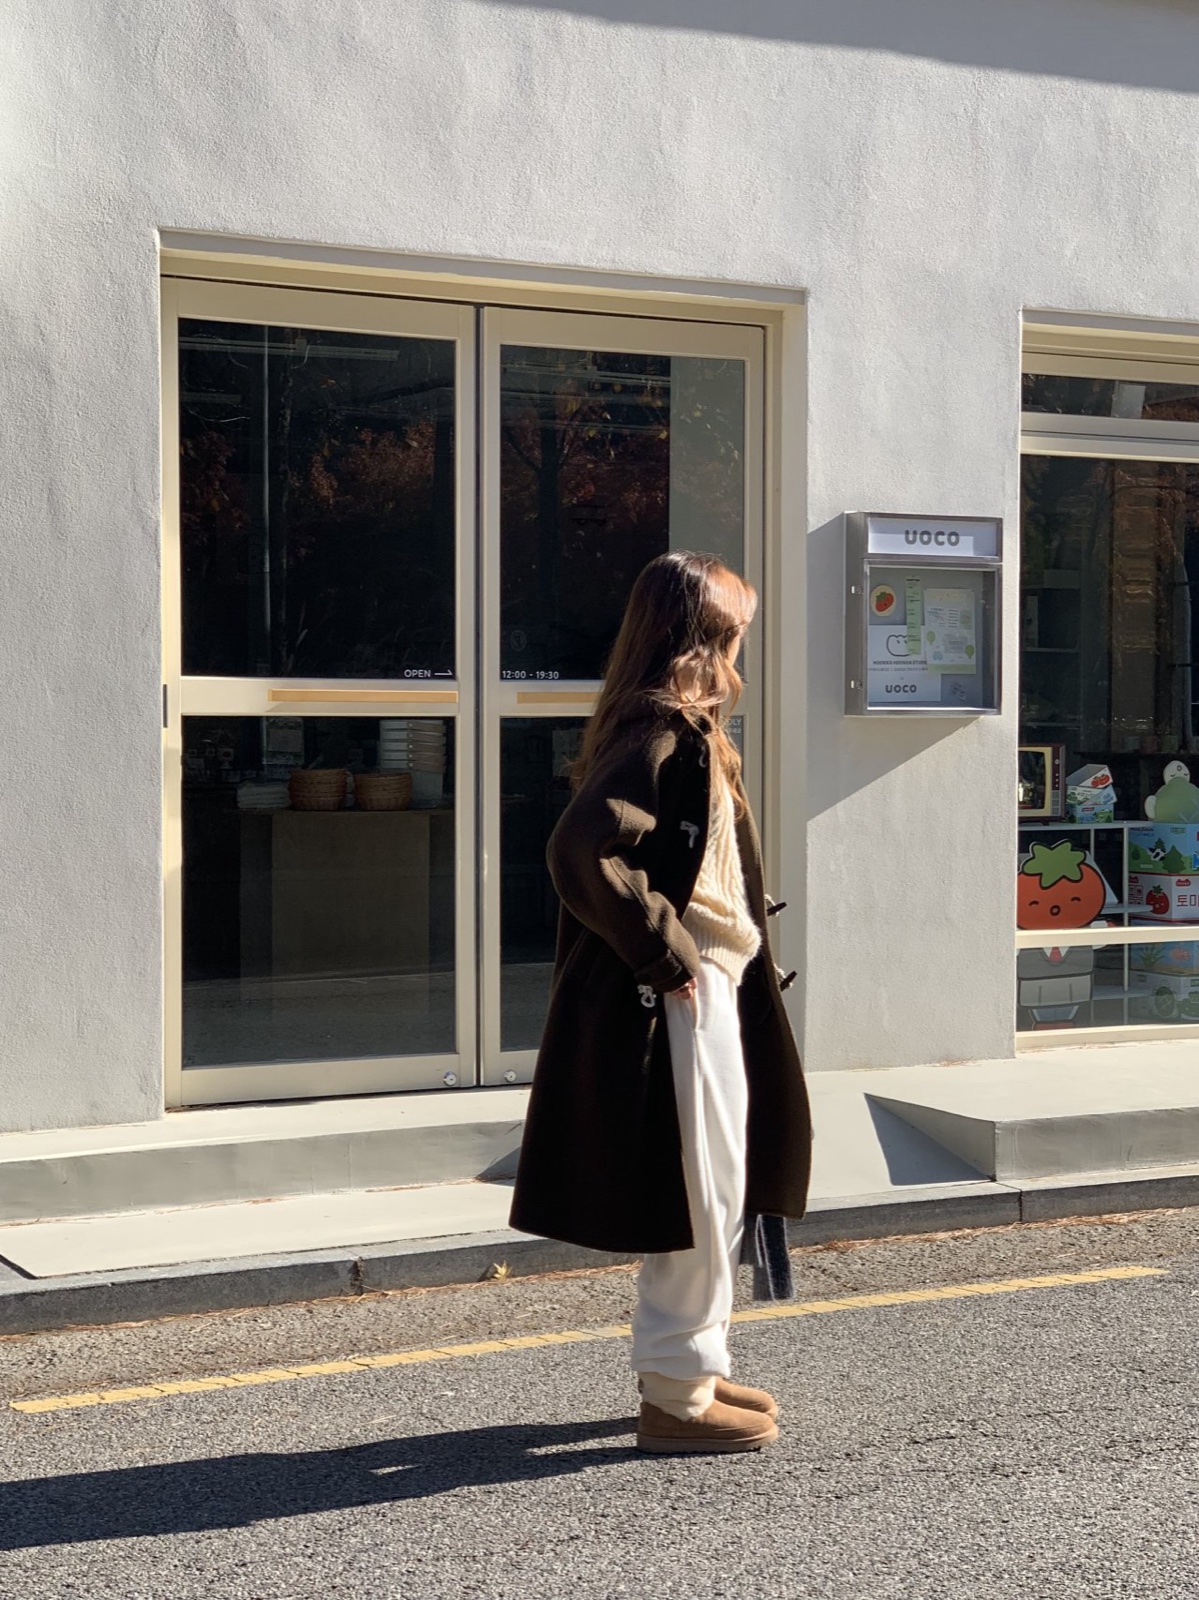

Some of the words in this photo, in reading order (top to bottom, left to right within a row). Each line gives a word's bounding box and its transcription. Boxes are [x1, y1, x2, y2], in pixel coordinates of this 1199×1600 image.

[904, 529, 960, 547] UOCO
[403, 669, 432, 678] OPEN
[502, 670, 527, 679] 12:00
[536, 670, 560, 680] 19:30
[885, 684, 917, 693] UOCO
